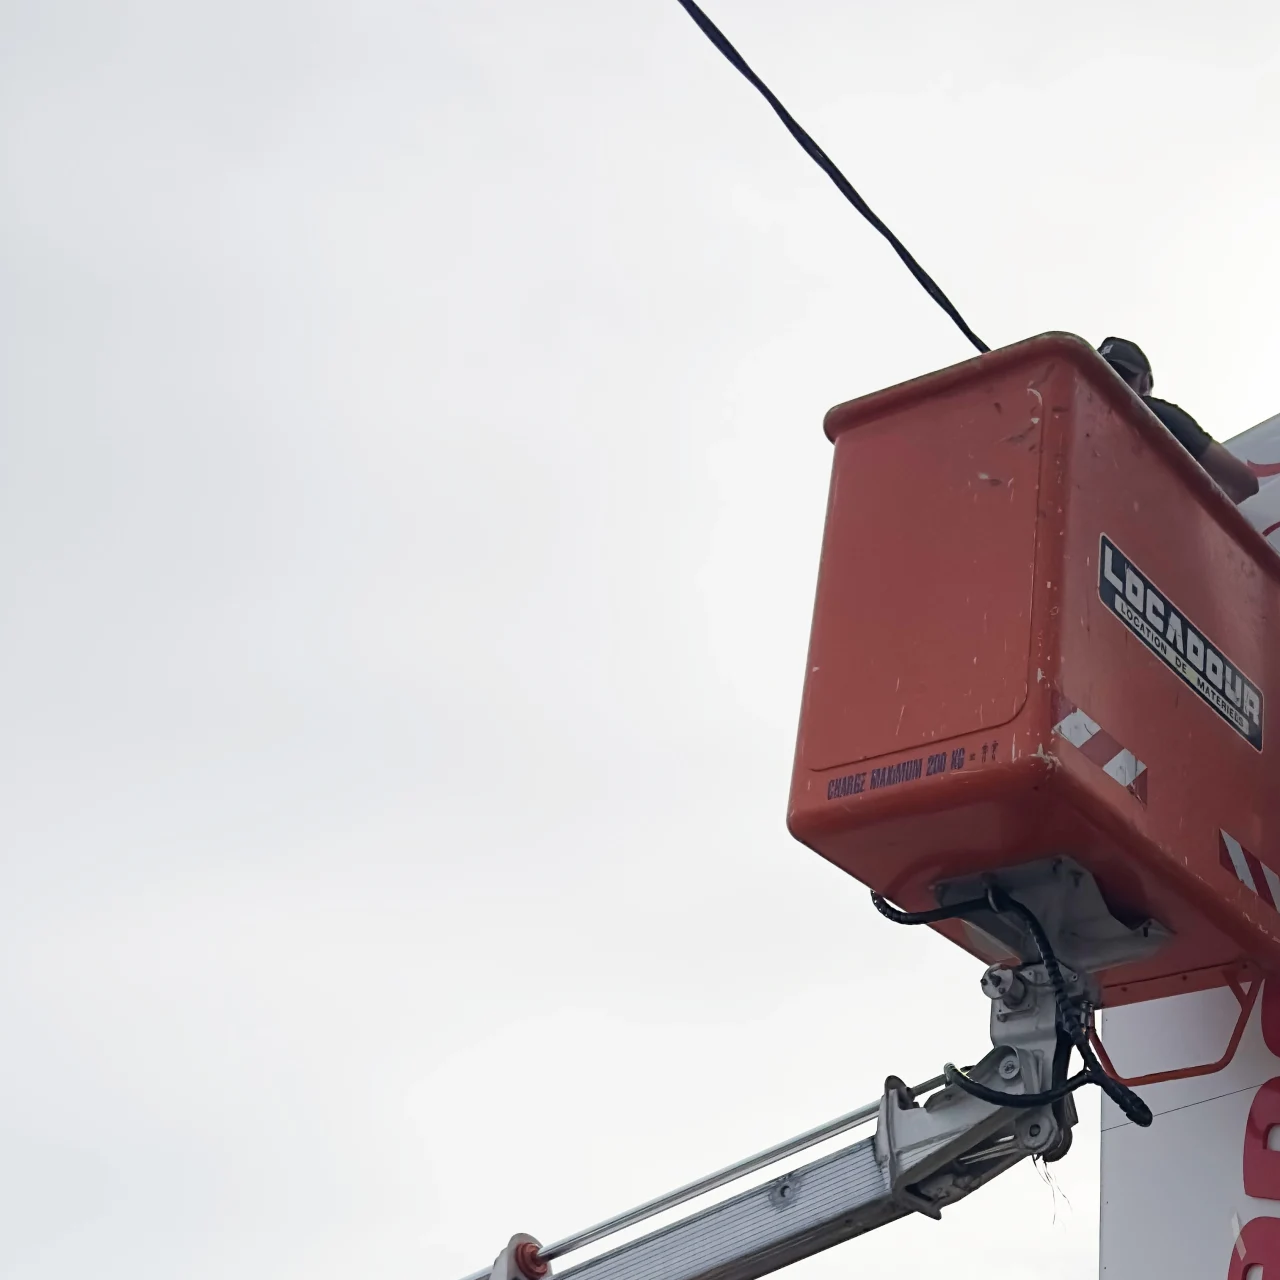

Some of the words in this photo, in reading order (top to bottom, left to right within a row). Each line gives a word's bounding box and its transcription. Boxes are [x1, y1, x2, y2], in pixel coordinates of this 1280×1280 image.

[1103, 544, 1260, 727] LOCADOUR
[1120, 600, 1168, 656] LOCATION
[1175, 655, 1188, 675] DE
[1196, 677, 1245, 728] MATERIELS
[827, 771, 867, 800] CHARGE
[869, 758, 923, 790] MAXIMUM
[926, 751, 948, 777] 200
[951, 747, 965, 770] KG
